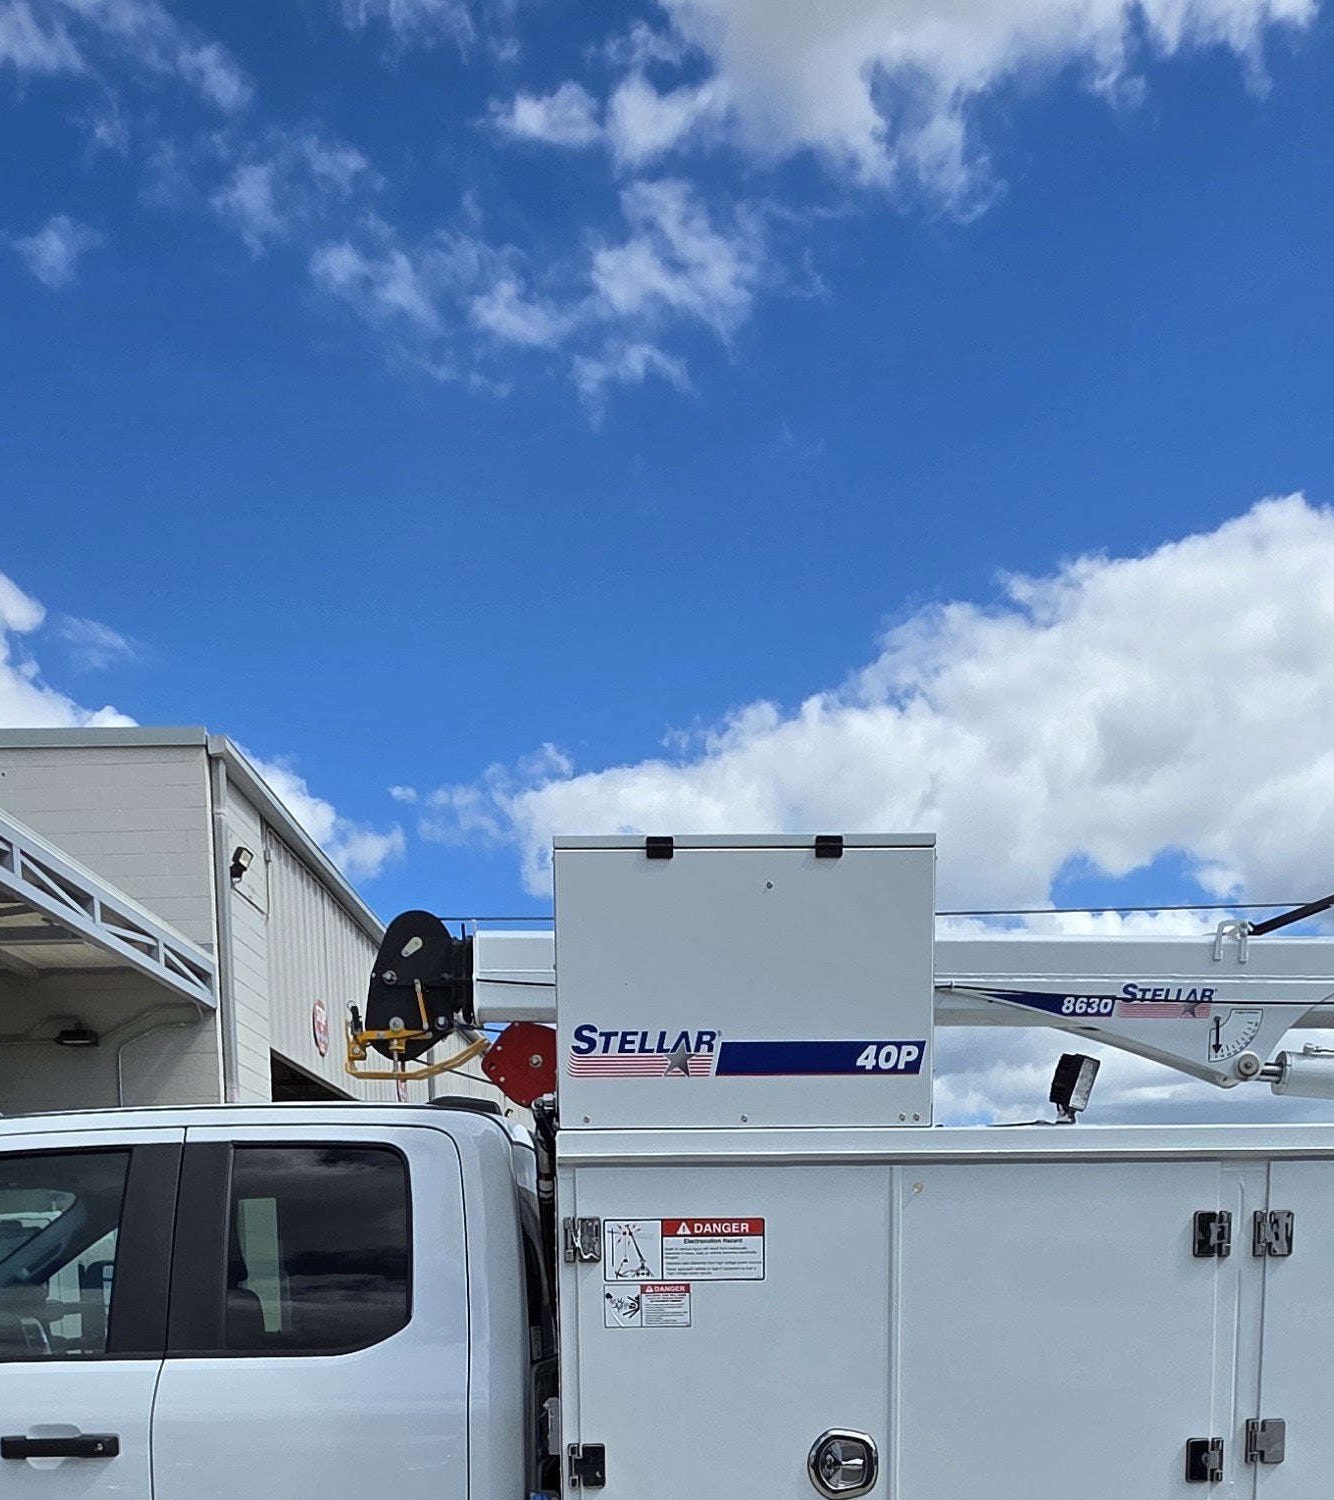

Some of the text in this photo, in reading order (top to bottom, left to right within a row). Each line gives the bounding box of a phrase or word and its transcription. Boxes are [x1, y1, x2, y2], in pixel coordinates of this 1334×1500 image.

[1121, 983, 1215, 1003] STELLAR
[1061, 997, 1113, 1014] 8630
[572, 1024, 717, 1054] STELLAR
[856, 1045, 919, 1070] 40P
[694, 1223, 749, 1234] DANGER
